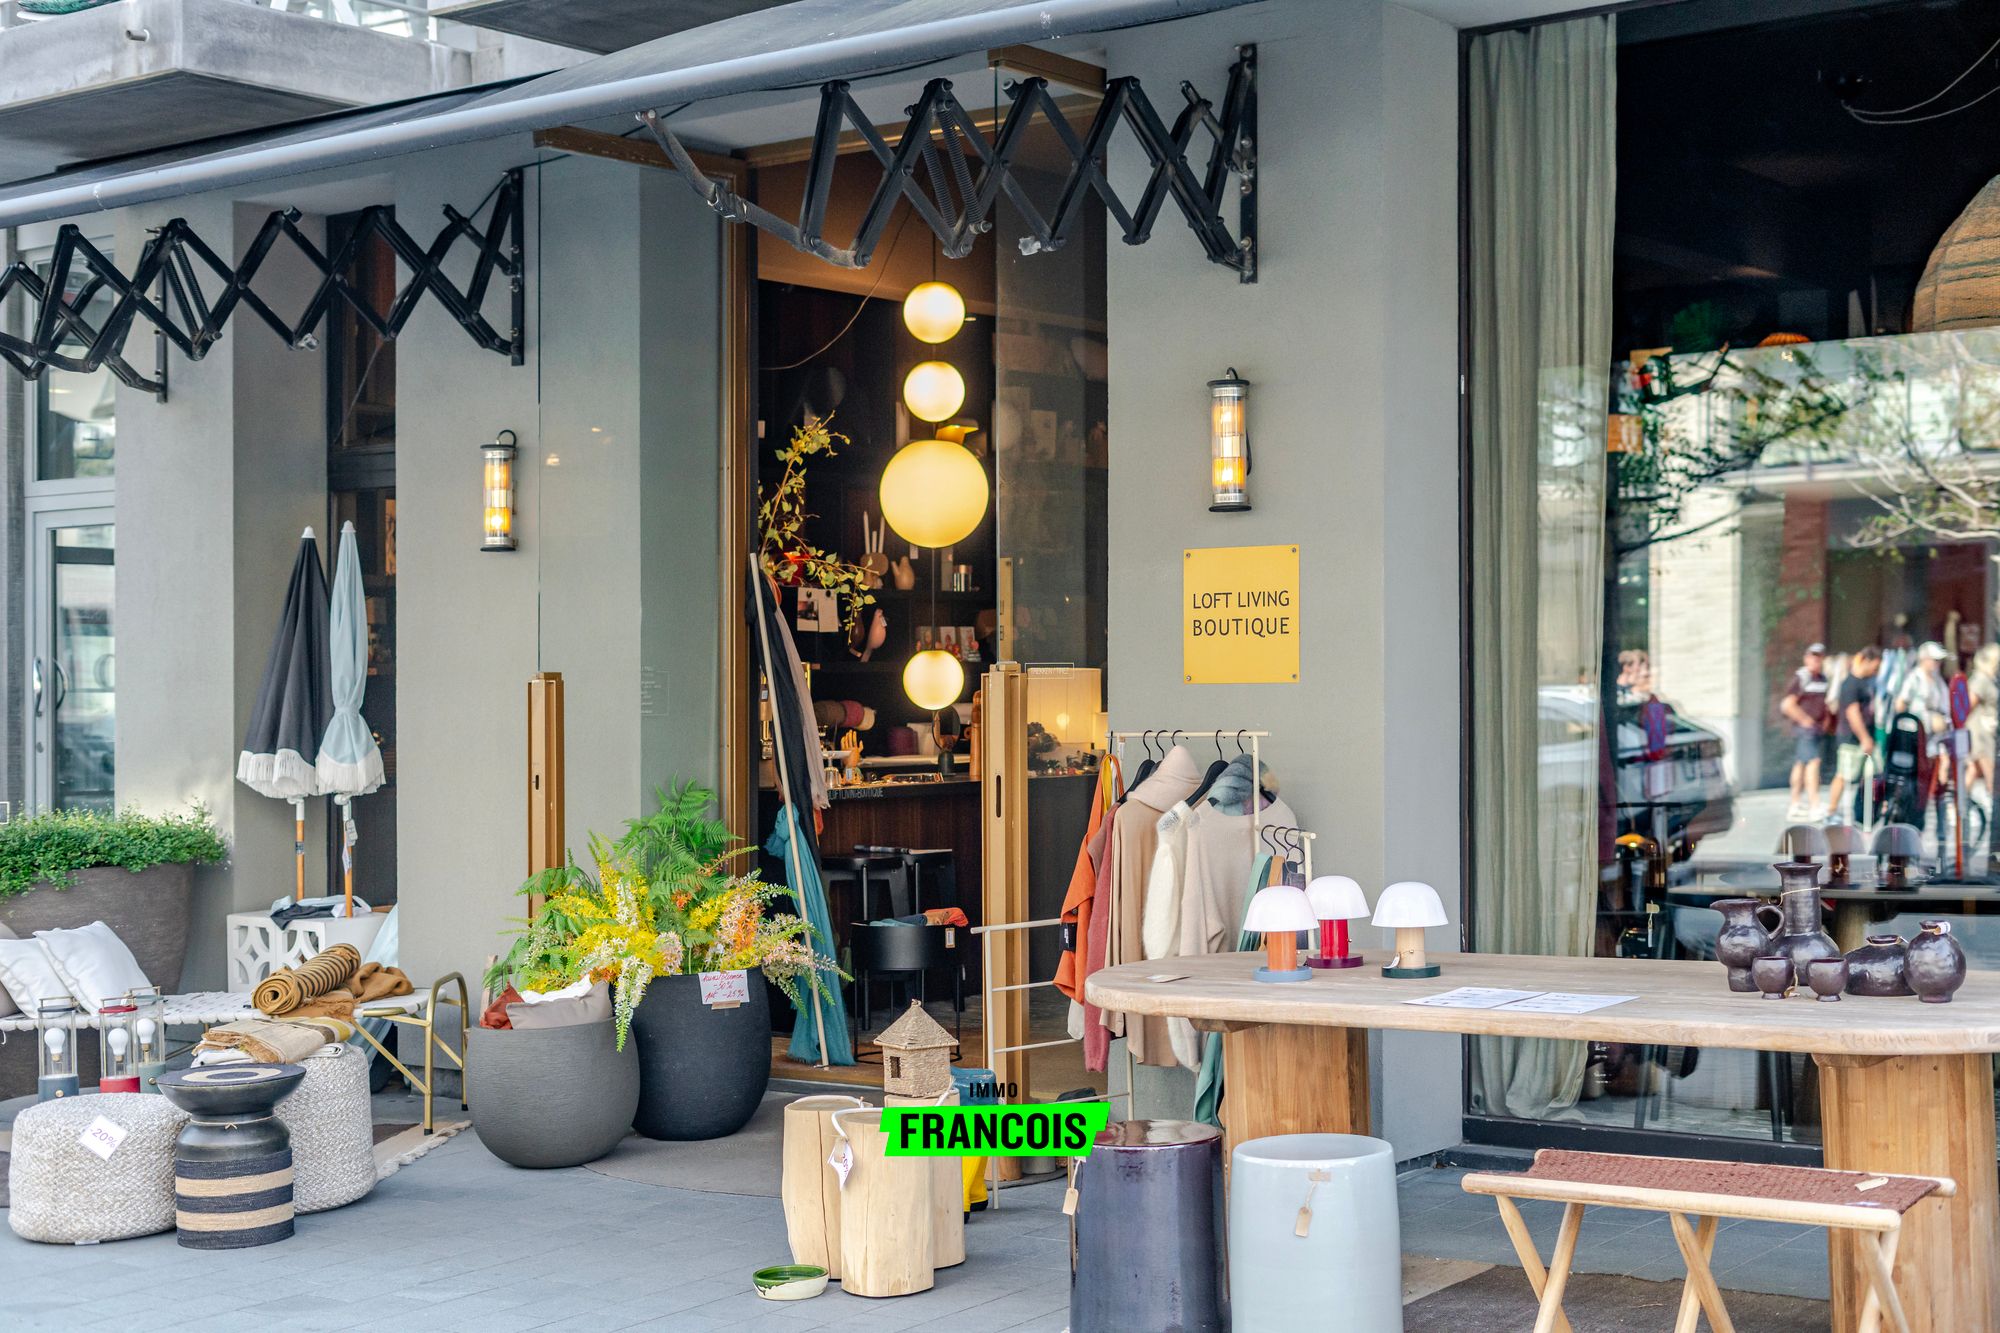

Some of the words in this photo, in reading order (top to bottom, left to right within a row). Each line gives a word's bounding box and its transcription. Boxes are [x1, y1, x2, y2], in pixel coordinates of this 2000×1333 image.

[1192, 592, 1232, 609] LOFT
[1237, 590, 1290, 608] LIVING
[1192, 617, 1290, 638] BOUTIQUE
